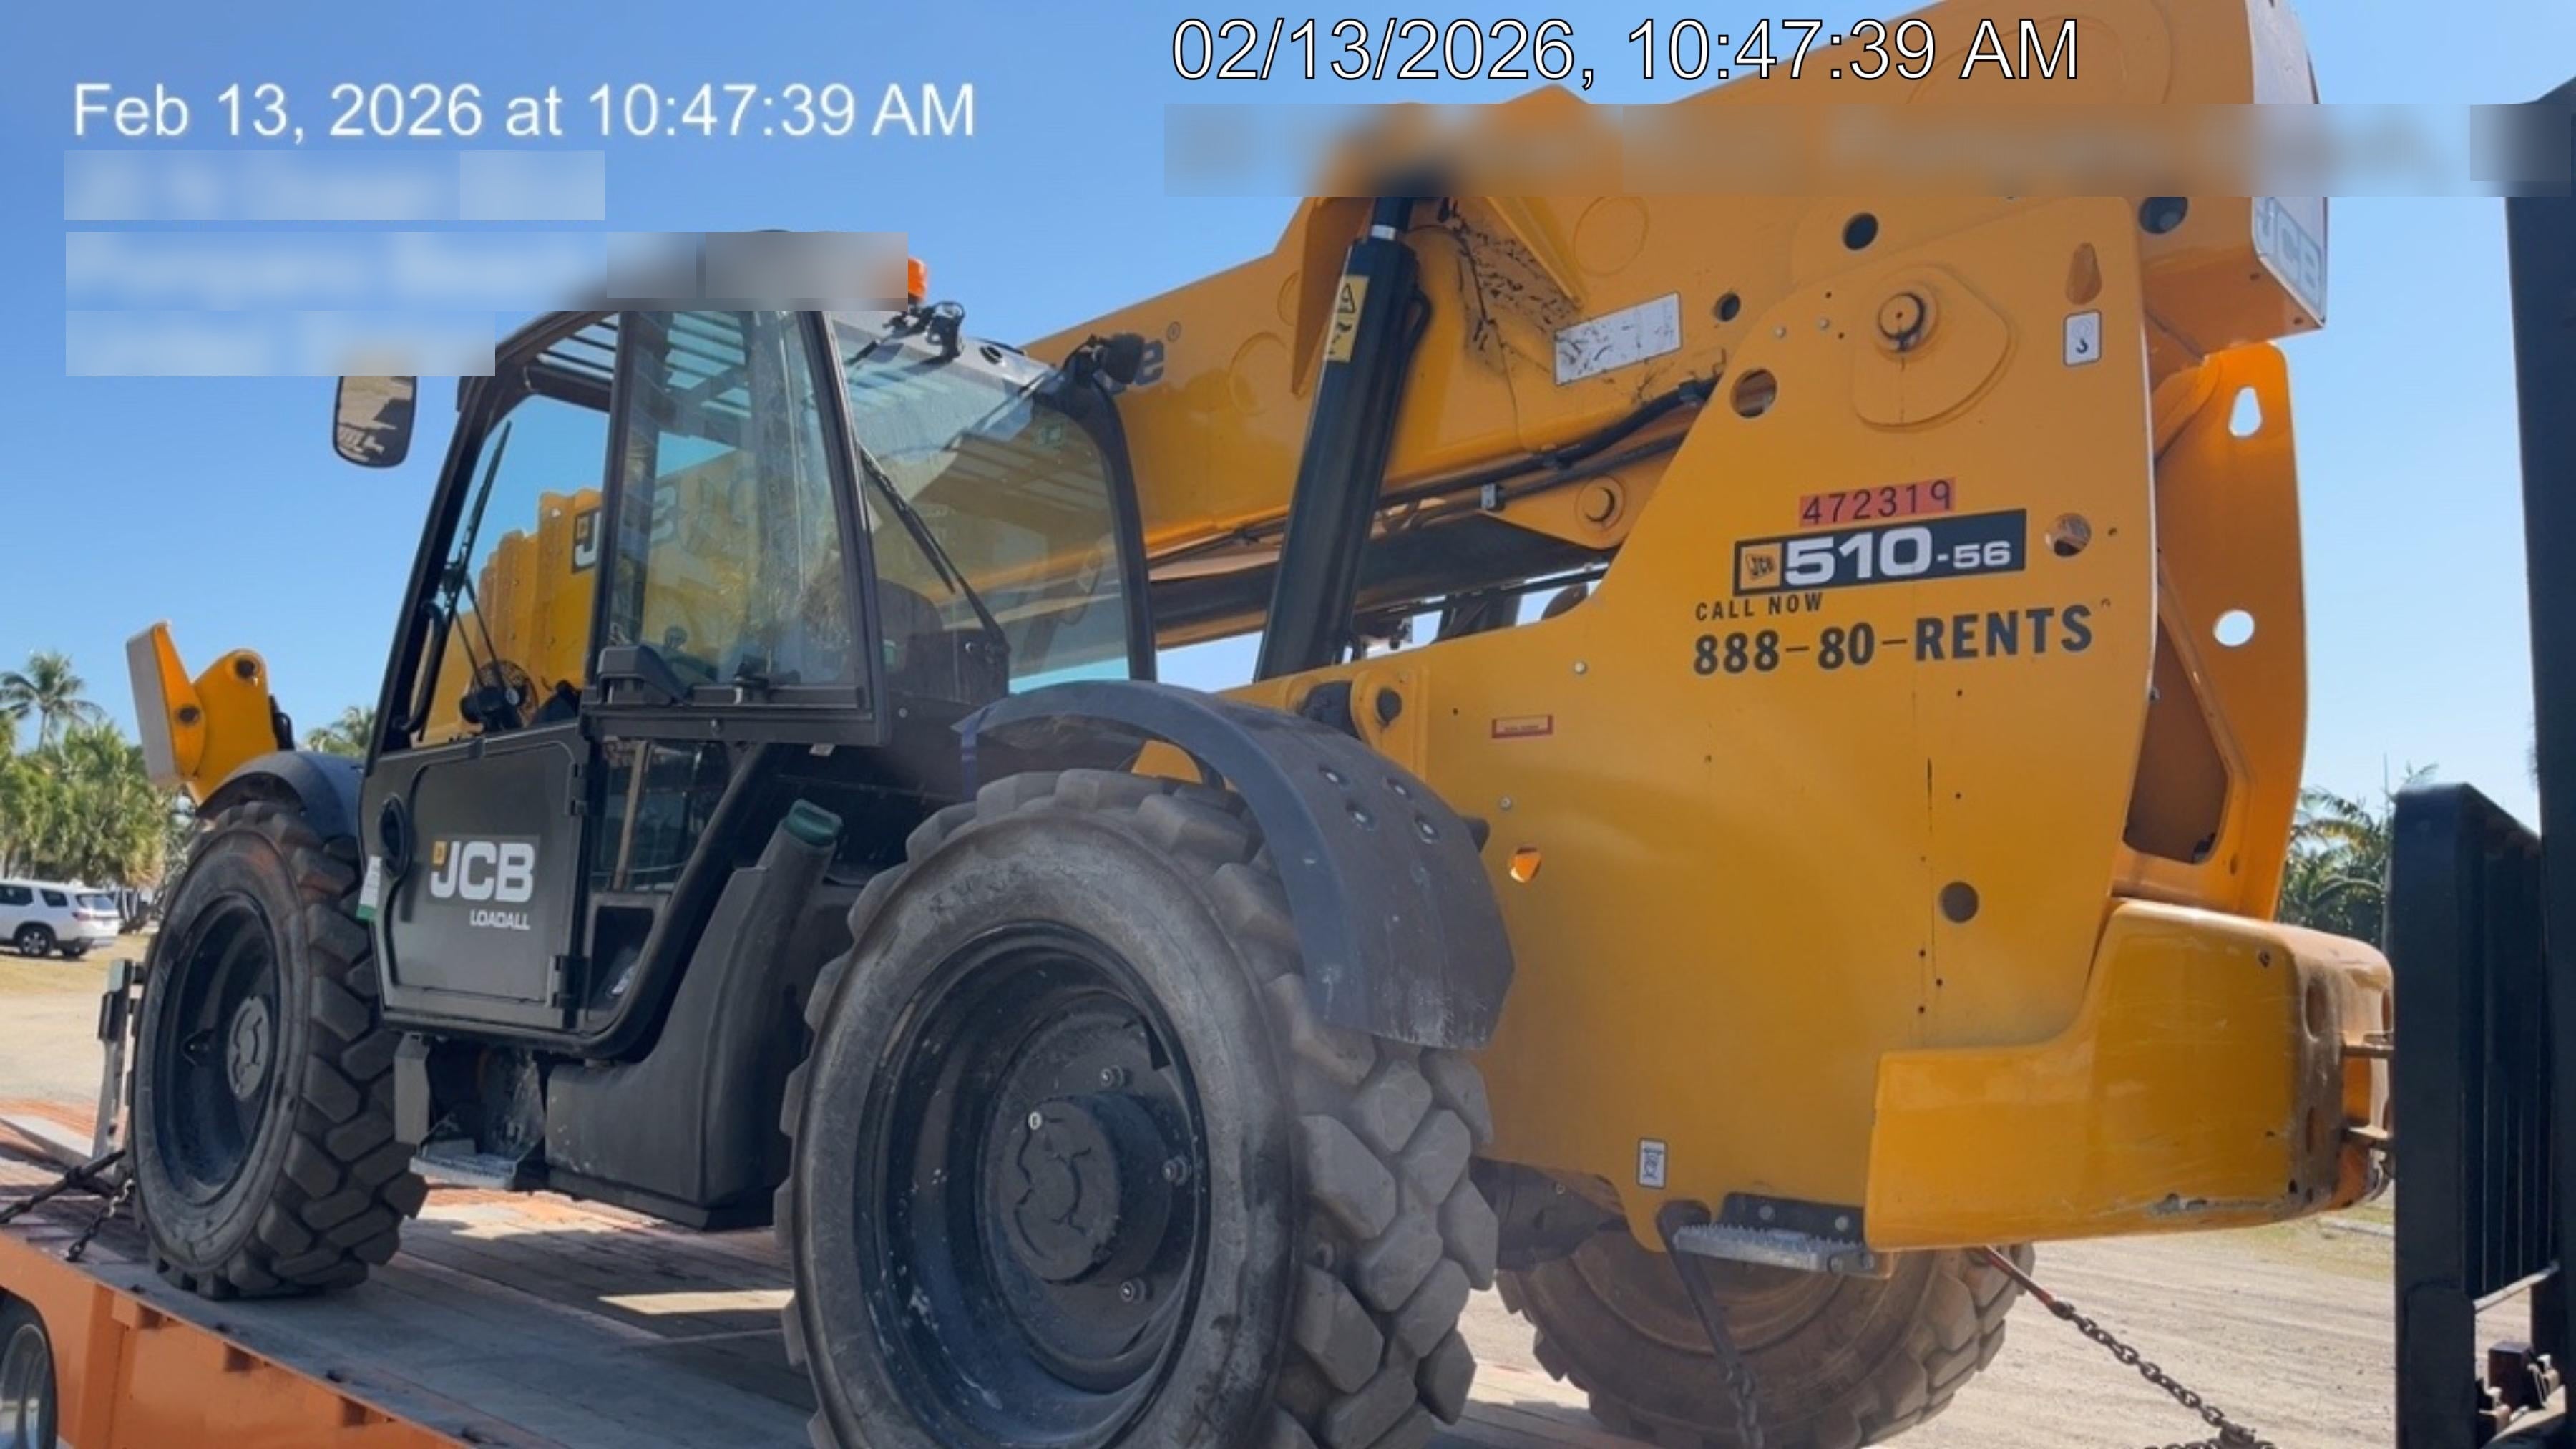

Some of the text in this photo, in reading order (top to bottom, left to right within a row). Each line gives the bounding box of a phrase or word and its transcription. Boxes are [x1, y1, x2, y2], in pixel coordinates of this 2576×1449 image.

[1802, 479, 1953, 524] 472319
[1785, 527, 2012, 585] 510-56
[1695, 592, 1823, 621] CALL NOW
[431, 841, 535, 902] JCB
[469, 909, 530, 930] LOADALL
